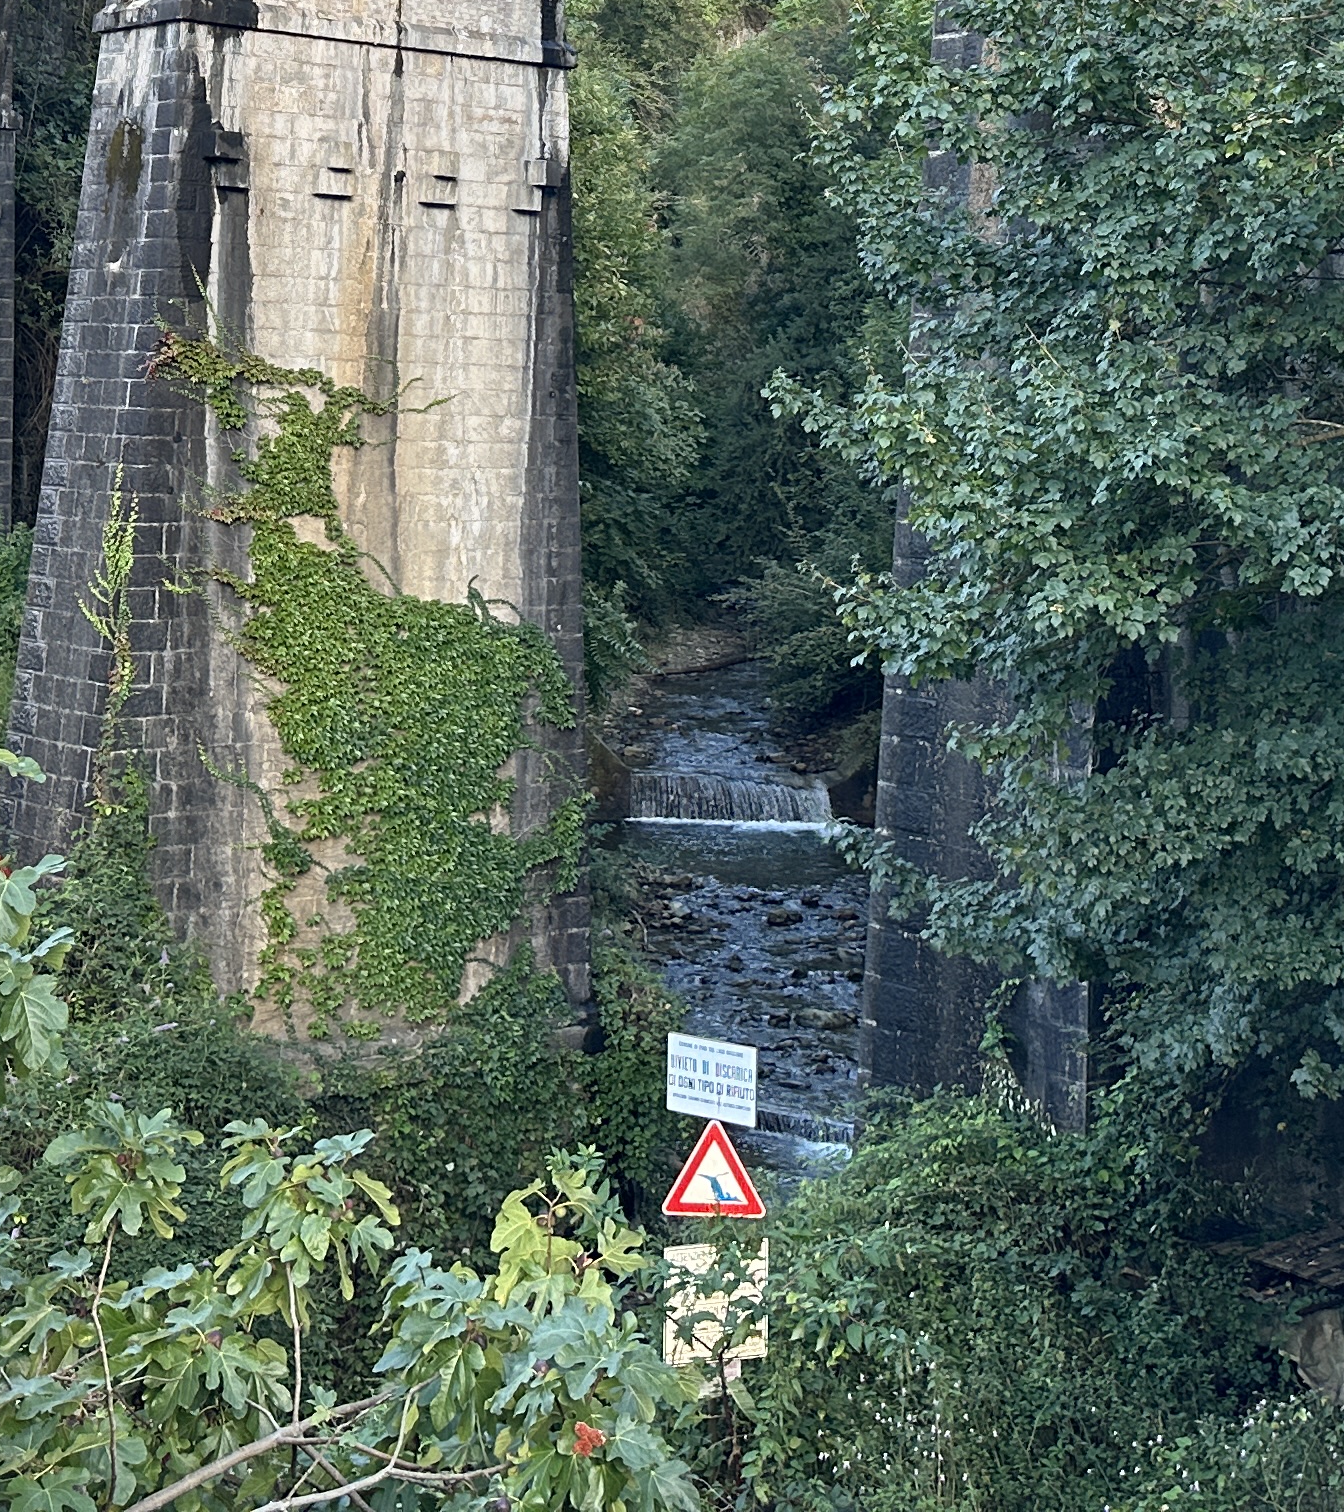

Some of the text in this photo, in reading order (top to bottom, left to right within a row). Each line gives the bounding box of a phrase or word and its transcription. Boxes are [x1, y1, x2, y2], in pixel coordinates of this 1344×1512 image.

[670, 1054, 753, 1083] DIVIETO DI DISCARICA
[668, 1074, 676, 1086] DI
[698, 1079, 714, 1093] TIPO
[716, 1082, 724, 1096] DI
[726, 1084, 755, 1101] RIFIUTO
